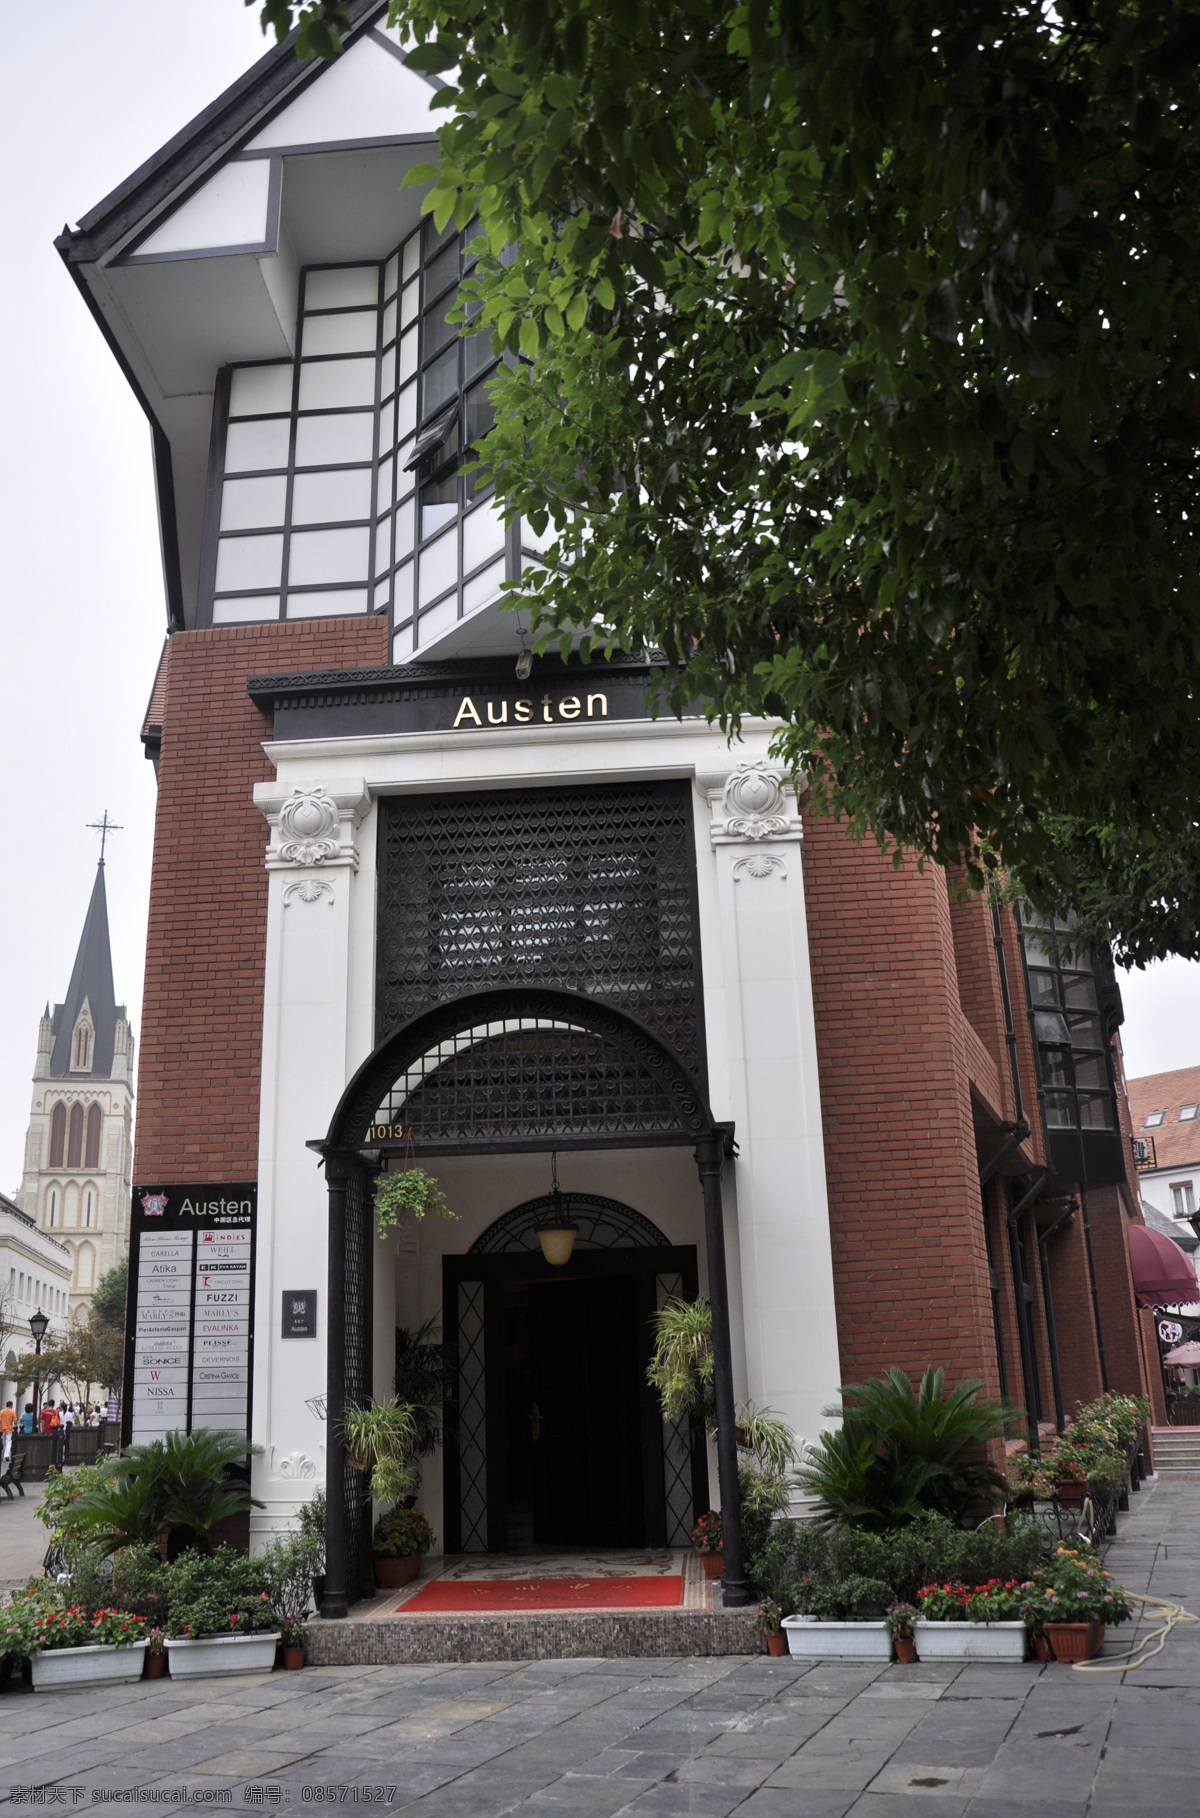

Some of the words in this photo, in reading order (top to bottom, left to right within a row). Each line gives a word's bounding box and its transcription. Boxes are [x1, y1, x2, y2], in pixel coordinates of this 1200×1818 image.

[453, 692, 608, 728] Austen
[371, 1124, 403, 1139] 1013
[178, 1198, 252, 1216] Austen
[152, 1264, 177, 1274] Atika
[206, 1294, 238, 1302] FUZZI
[150, 1370, 161, 1381] W
[147, 1388, 174, 1396] NISSA
